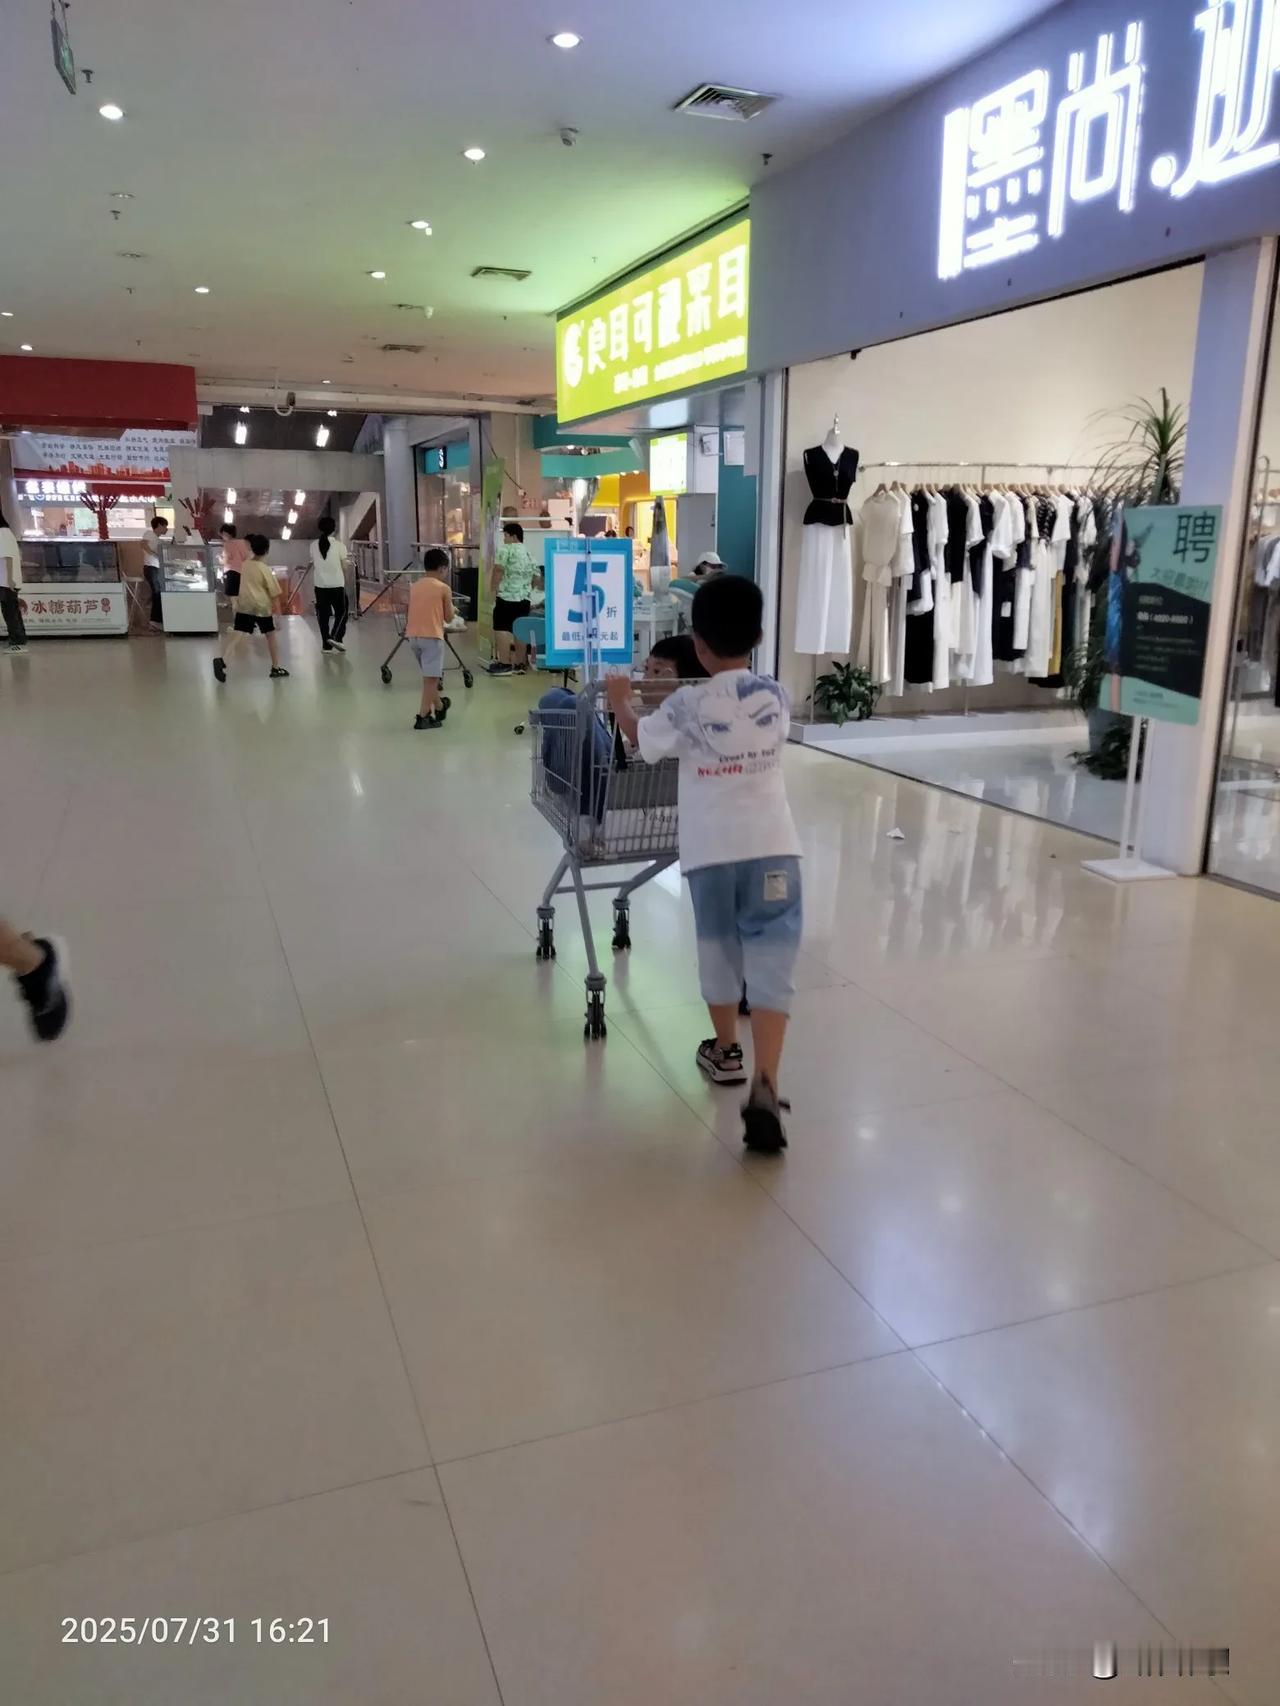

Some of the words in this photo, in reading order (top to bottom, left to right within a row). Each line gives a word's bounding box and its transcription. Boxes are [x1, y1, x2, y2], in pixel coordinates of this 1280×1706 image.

[1173, 511, 1217, 564] 聘
[31, 599, 98, 615] 冰糖葫芦
